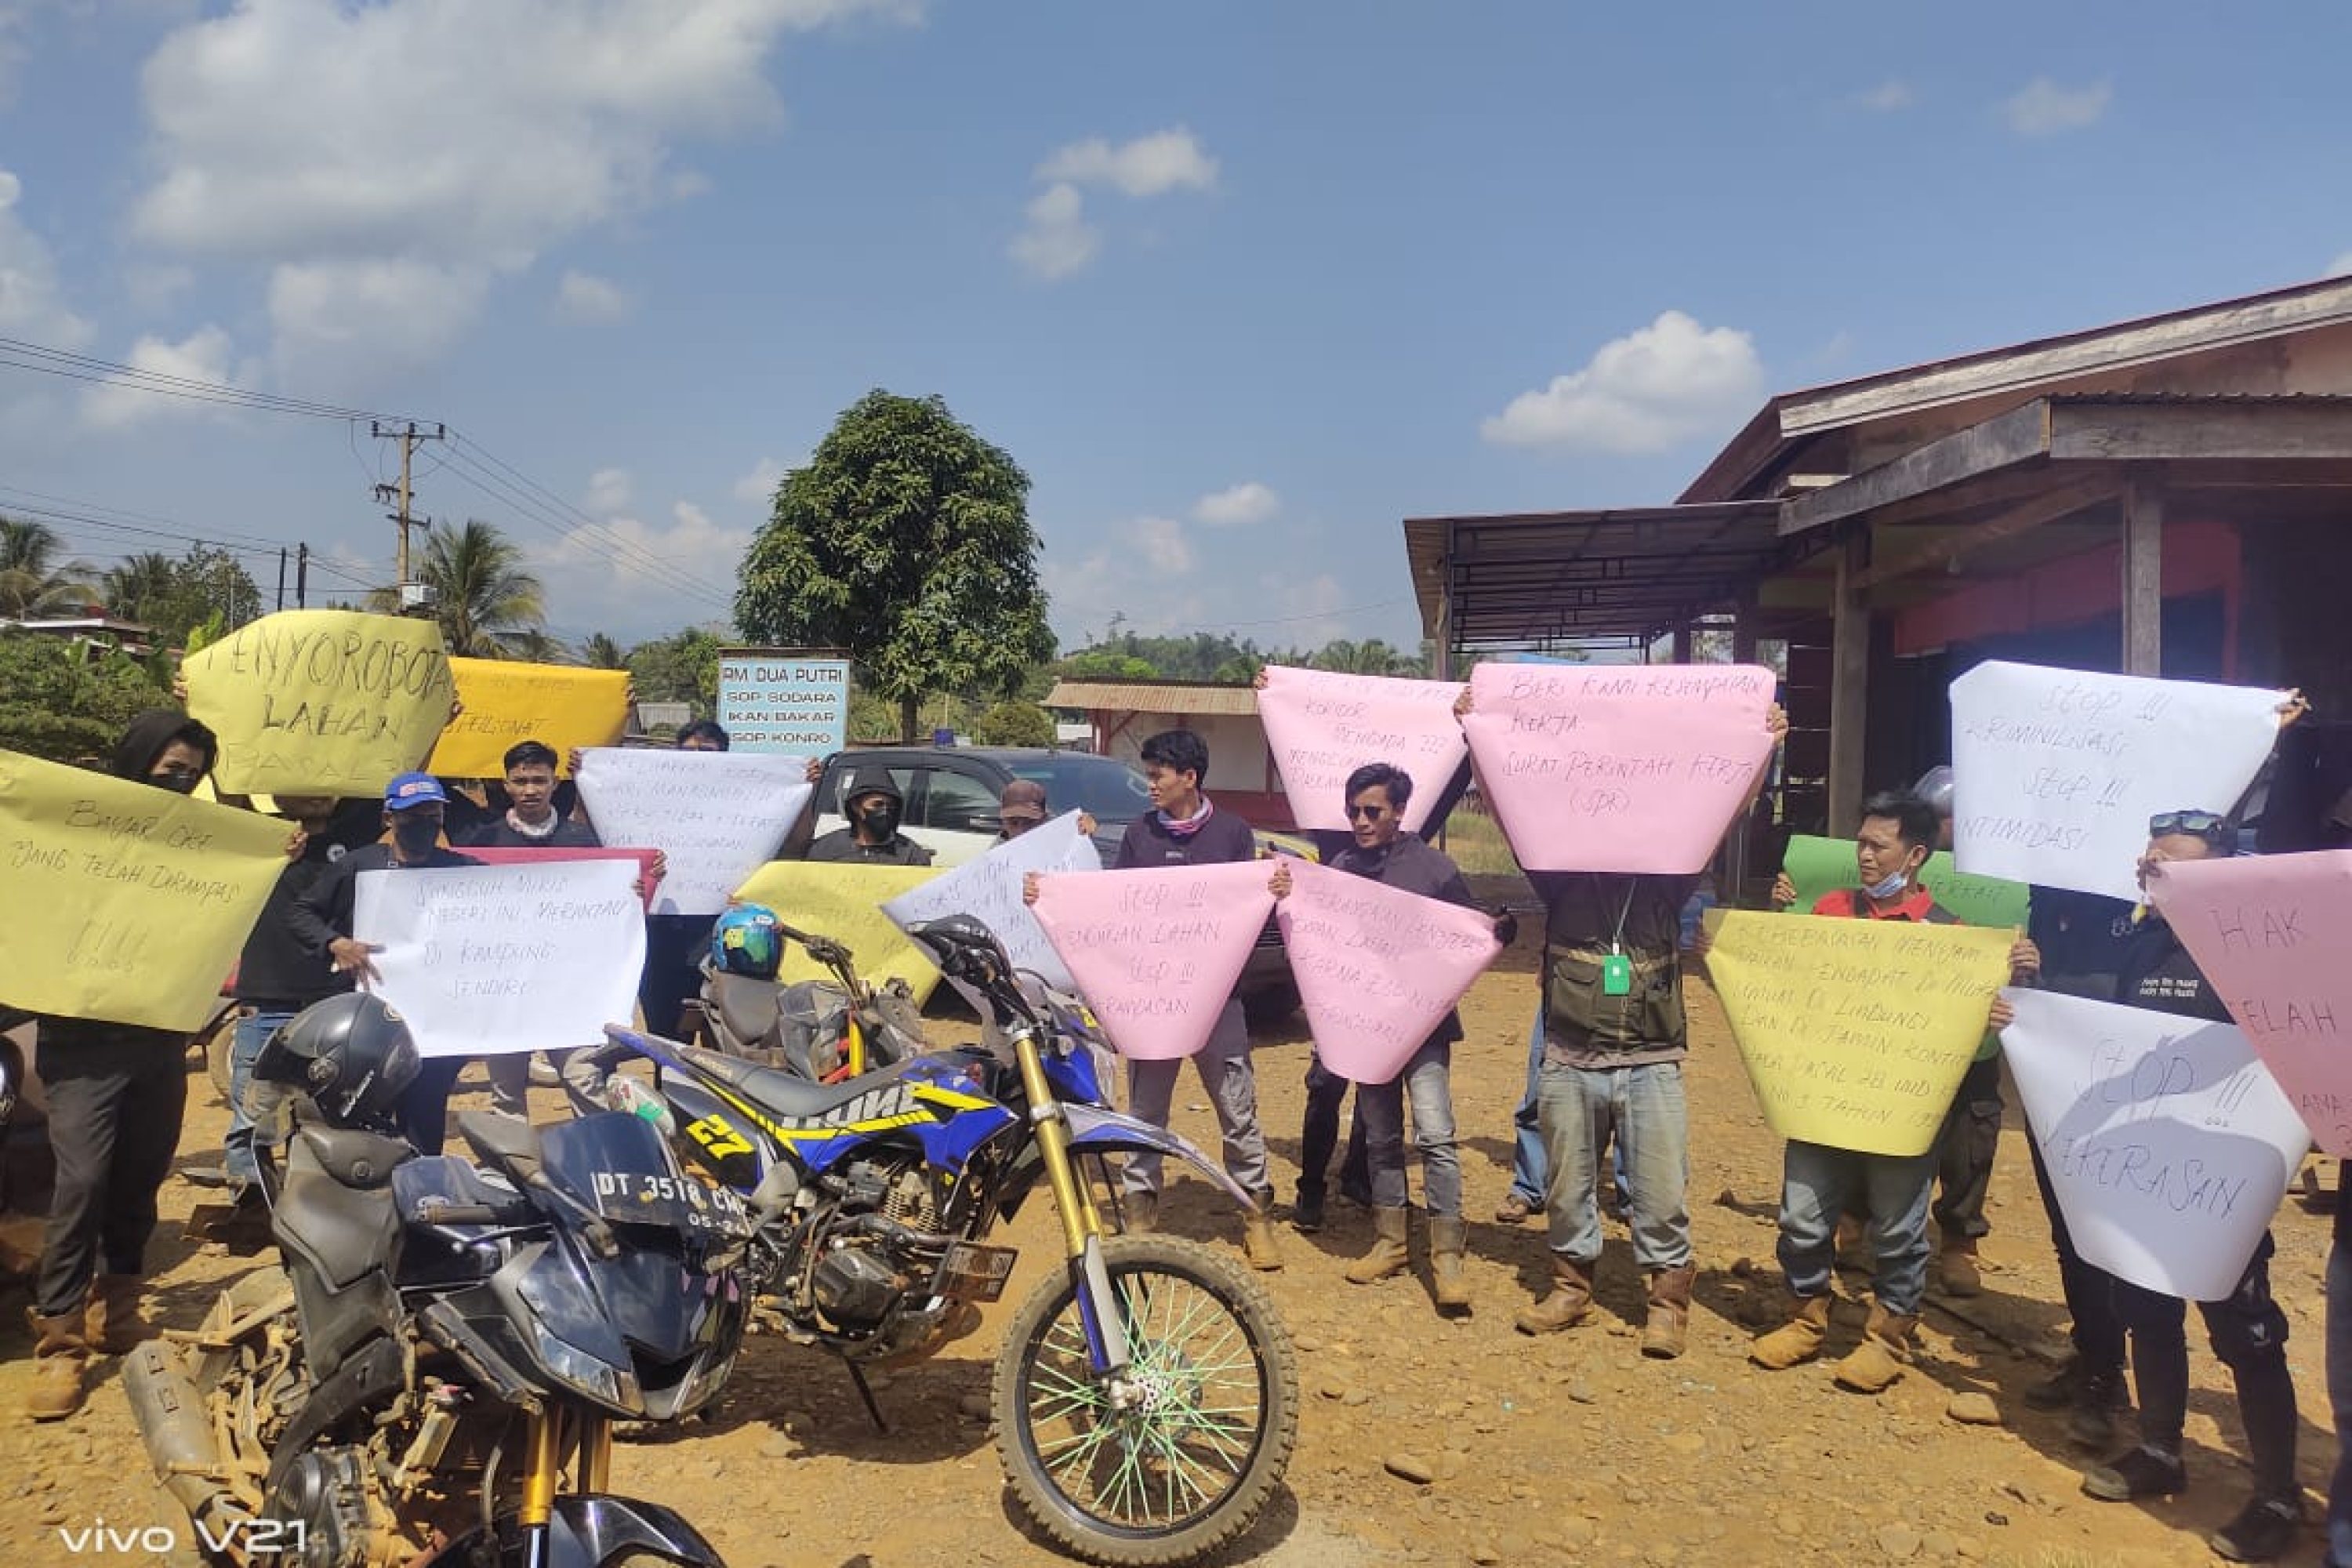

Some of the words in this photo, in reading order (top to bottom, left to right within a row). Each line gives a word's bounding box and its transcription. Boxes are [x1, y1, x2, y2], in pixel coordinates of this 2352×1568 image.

[723, 666, 748, 681] RM
[756, 667, 789, 682] DUA
[796, 669, 842, 682] PUTRI
[726, 691, 760, 702] SOP
[768, 691, 836, 703] SODARA
[261, 693, 403, 742] LAHAN
[728, 712, 768, 721] IKAN
[775, 712, 835, 721] BAKAR
[732, 732, 766, 742] SOP
[771, 732, 832, 743] KONRO
[2209, 906, 2306, 953] HAK
[685, 1114, 755, 1160] 27
[597, 1173, 630, 1196] DT
